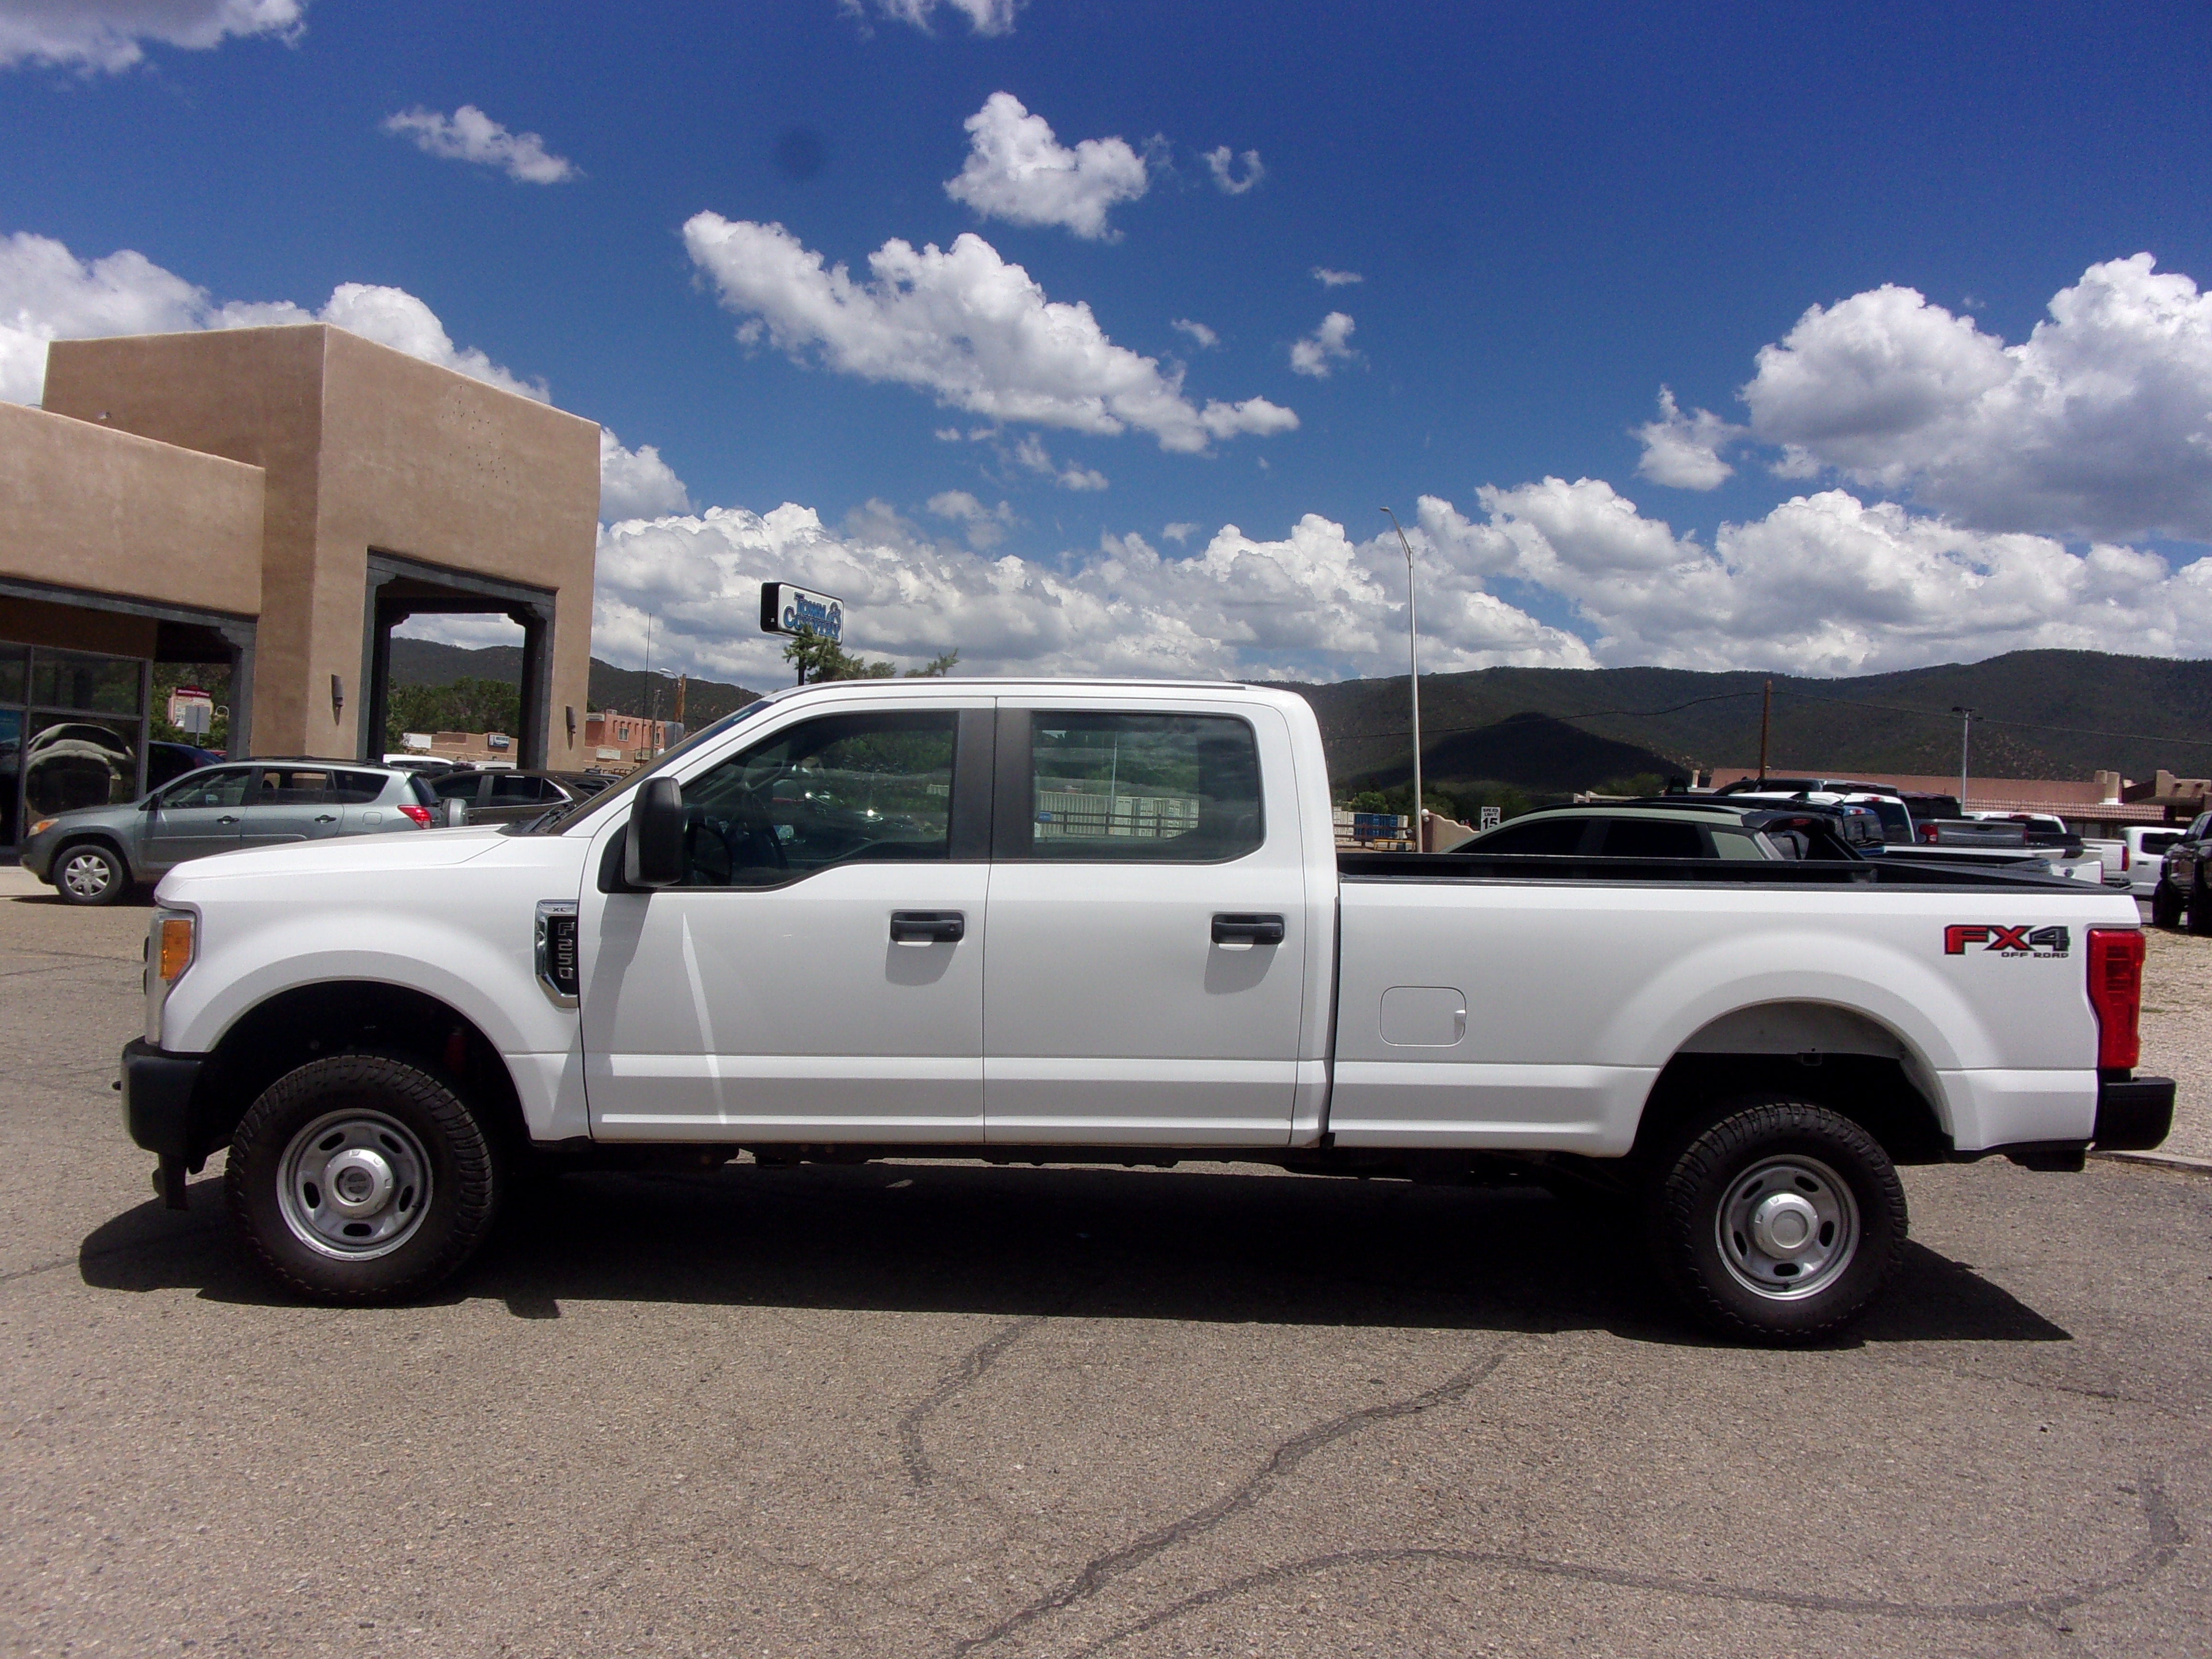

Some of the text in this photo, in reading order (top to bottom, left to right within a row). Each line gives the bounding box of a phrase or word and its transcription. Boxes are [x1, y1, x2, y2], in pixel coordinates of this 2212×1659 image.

[827, 601, 841, 624] &
[1483, 817, 1497, 829] 15
[1944, 925, 2070, 955] FX4
